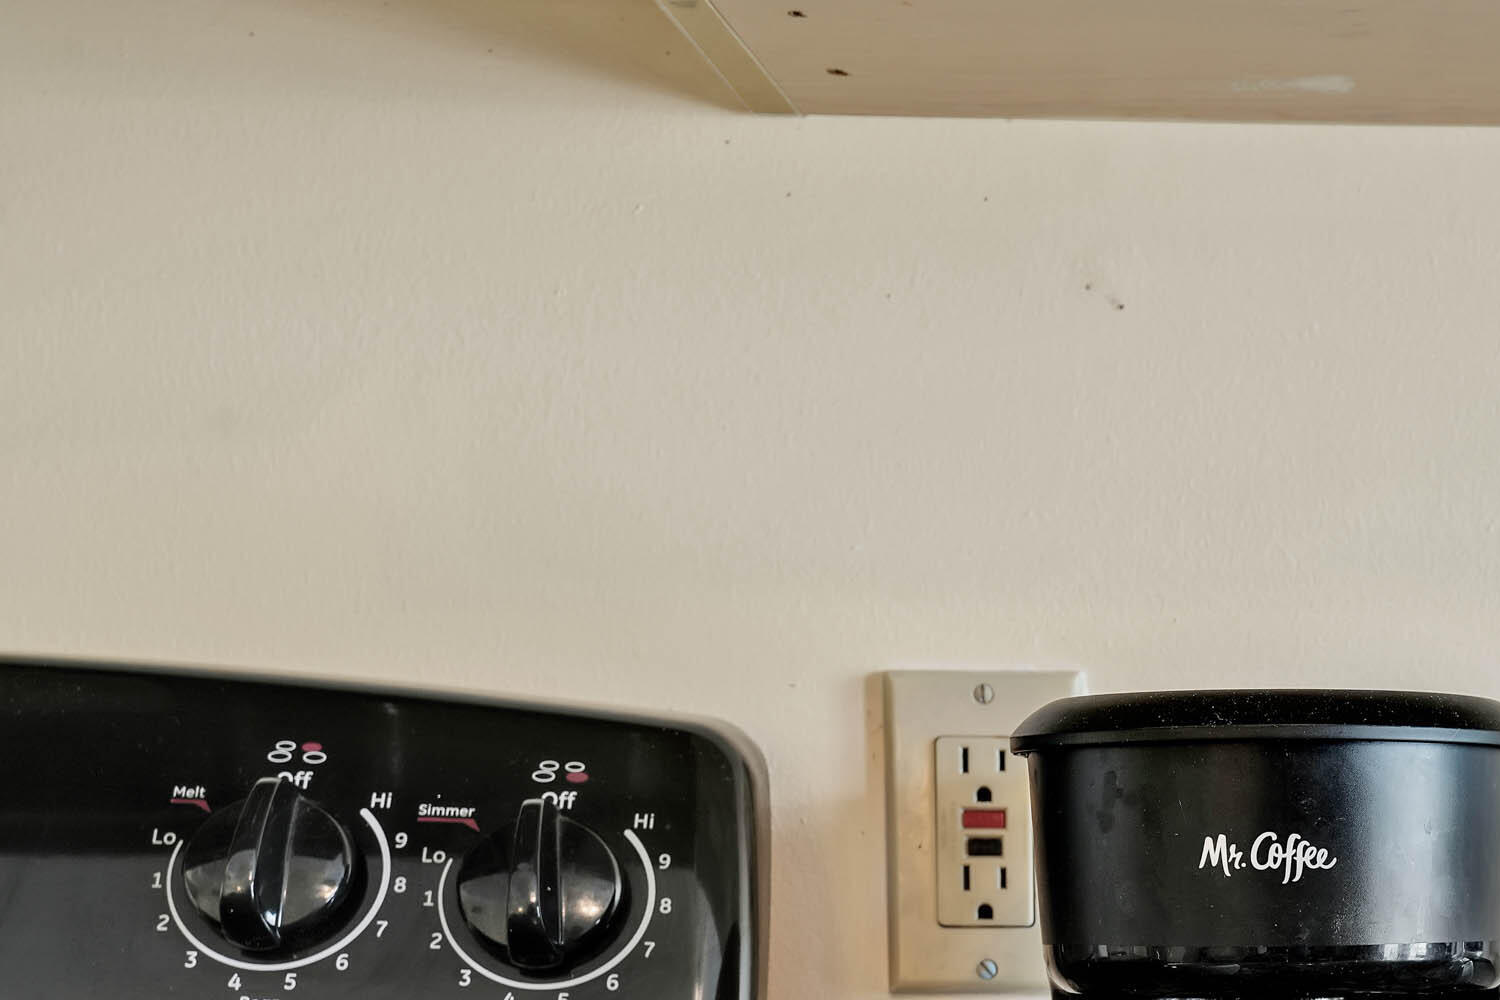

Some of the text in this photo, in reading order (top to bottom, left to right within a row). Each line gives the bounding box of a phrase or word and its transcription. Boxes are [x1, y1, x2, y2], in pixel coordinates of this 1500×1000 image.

[172, 785, 206, 799] Melt
[370, 791, 393, 809] Hi
[418, 803, 476, 818] Simmer
[633, 812, 656, 830] Hi
[151, 828, 177, 845] Lo
[395, 832, 408, 849] 9
[421, 846, 446, 864] Lo
[658, 853, 671, 870] 9
[1198, 831, 1337, 885] Mr. Coffee
[151, 871, 162, 889] 1
[393, 876, 407, 894] 8
[423, 890, 434, 907] 1
[659, 897, 672, 915] 8
[156, 914, 170, 932] 2
[376, 920, 389, 938] 7
[429, 932, 443, 950] 2
[643, 941, 656, 958] 7
[184, 950, 198, 969] 3
[335, 952, 349, 971] 6
[227, 972, 242, 991] 4
[283, 972, 297, 991] 5
[458, 968, 472, 987] 3
[606, 973, 620, 991] 6
